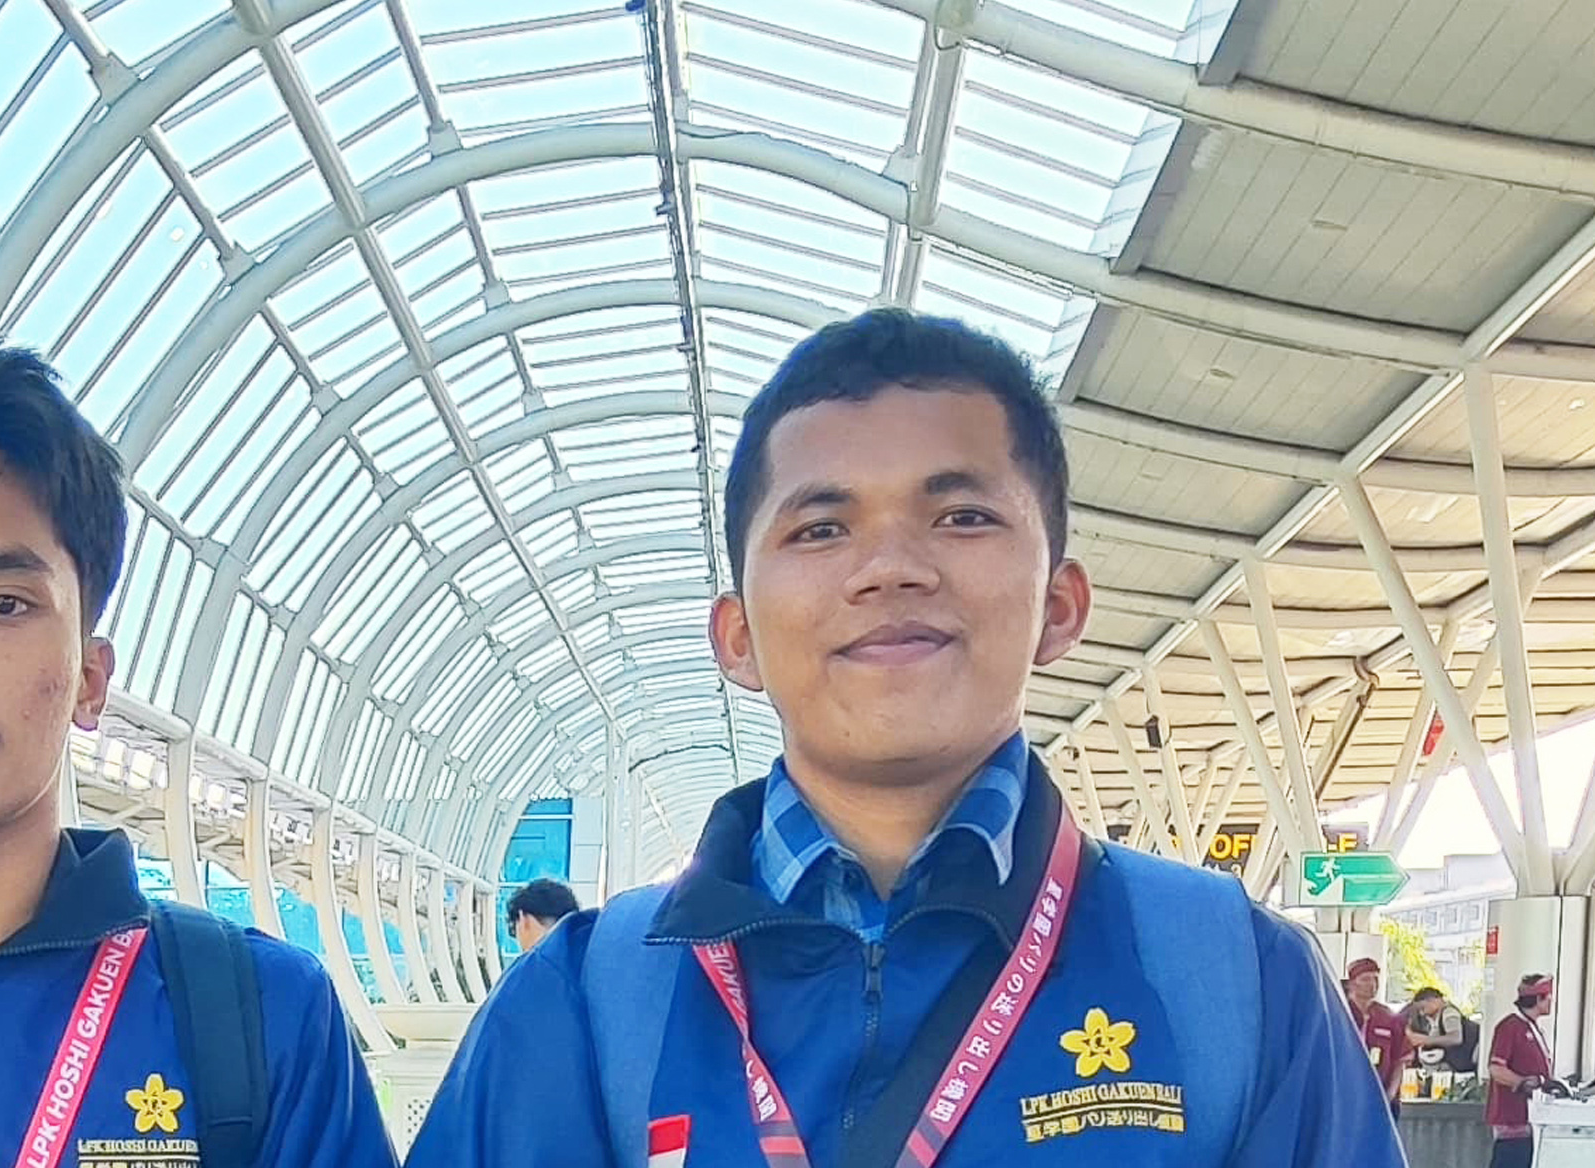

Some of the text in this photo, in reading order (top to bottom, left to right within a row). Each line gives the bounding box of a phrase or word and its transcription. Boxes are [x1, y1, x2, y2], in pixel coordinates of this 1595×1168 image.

[46, 1042, 91, 1121] HOSHI
[76, 949, 126, 1040] GAKUEN
[1050, 1084, 1098, 1106] HOSHI
